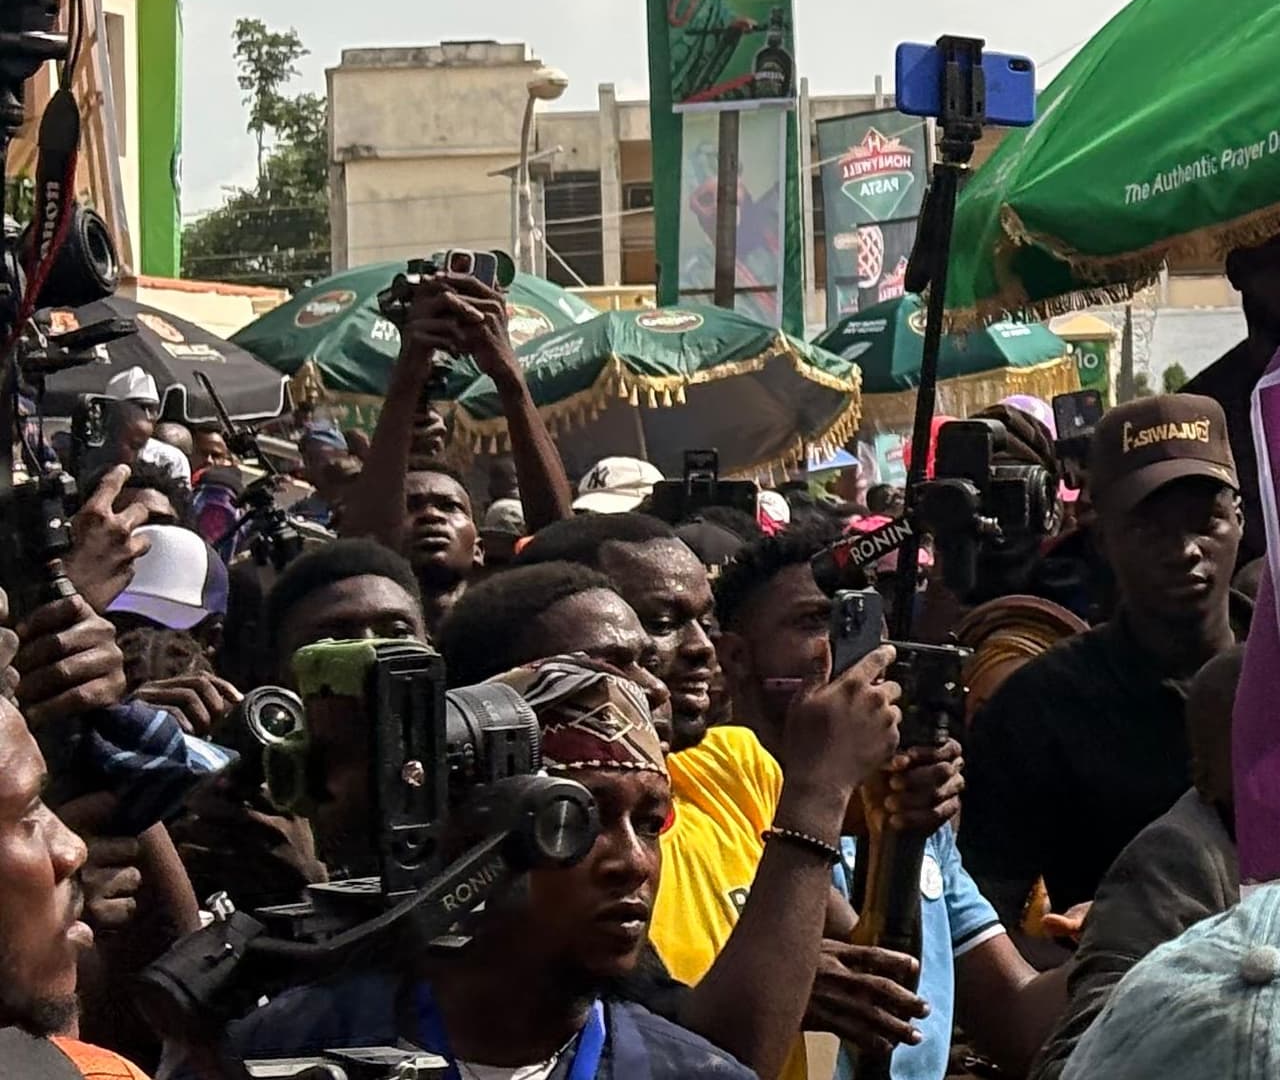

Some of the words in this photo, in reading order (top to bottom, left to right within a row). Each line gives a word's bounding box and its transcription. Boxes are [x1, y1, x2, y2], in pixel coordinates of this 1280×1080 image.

[1124, 182, 1150, 205] The
[1152, 154, 1219, 196] Authentic
[1220, 139, 1266, 170] Prayer
[849, 519, 914, 566] RONIN
[440, 855, 505, 912] RONIN
